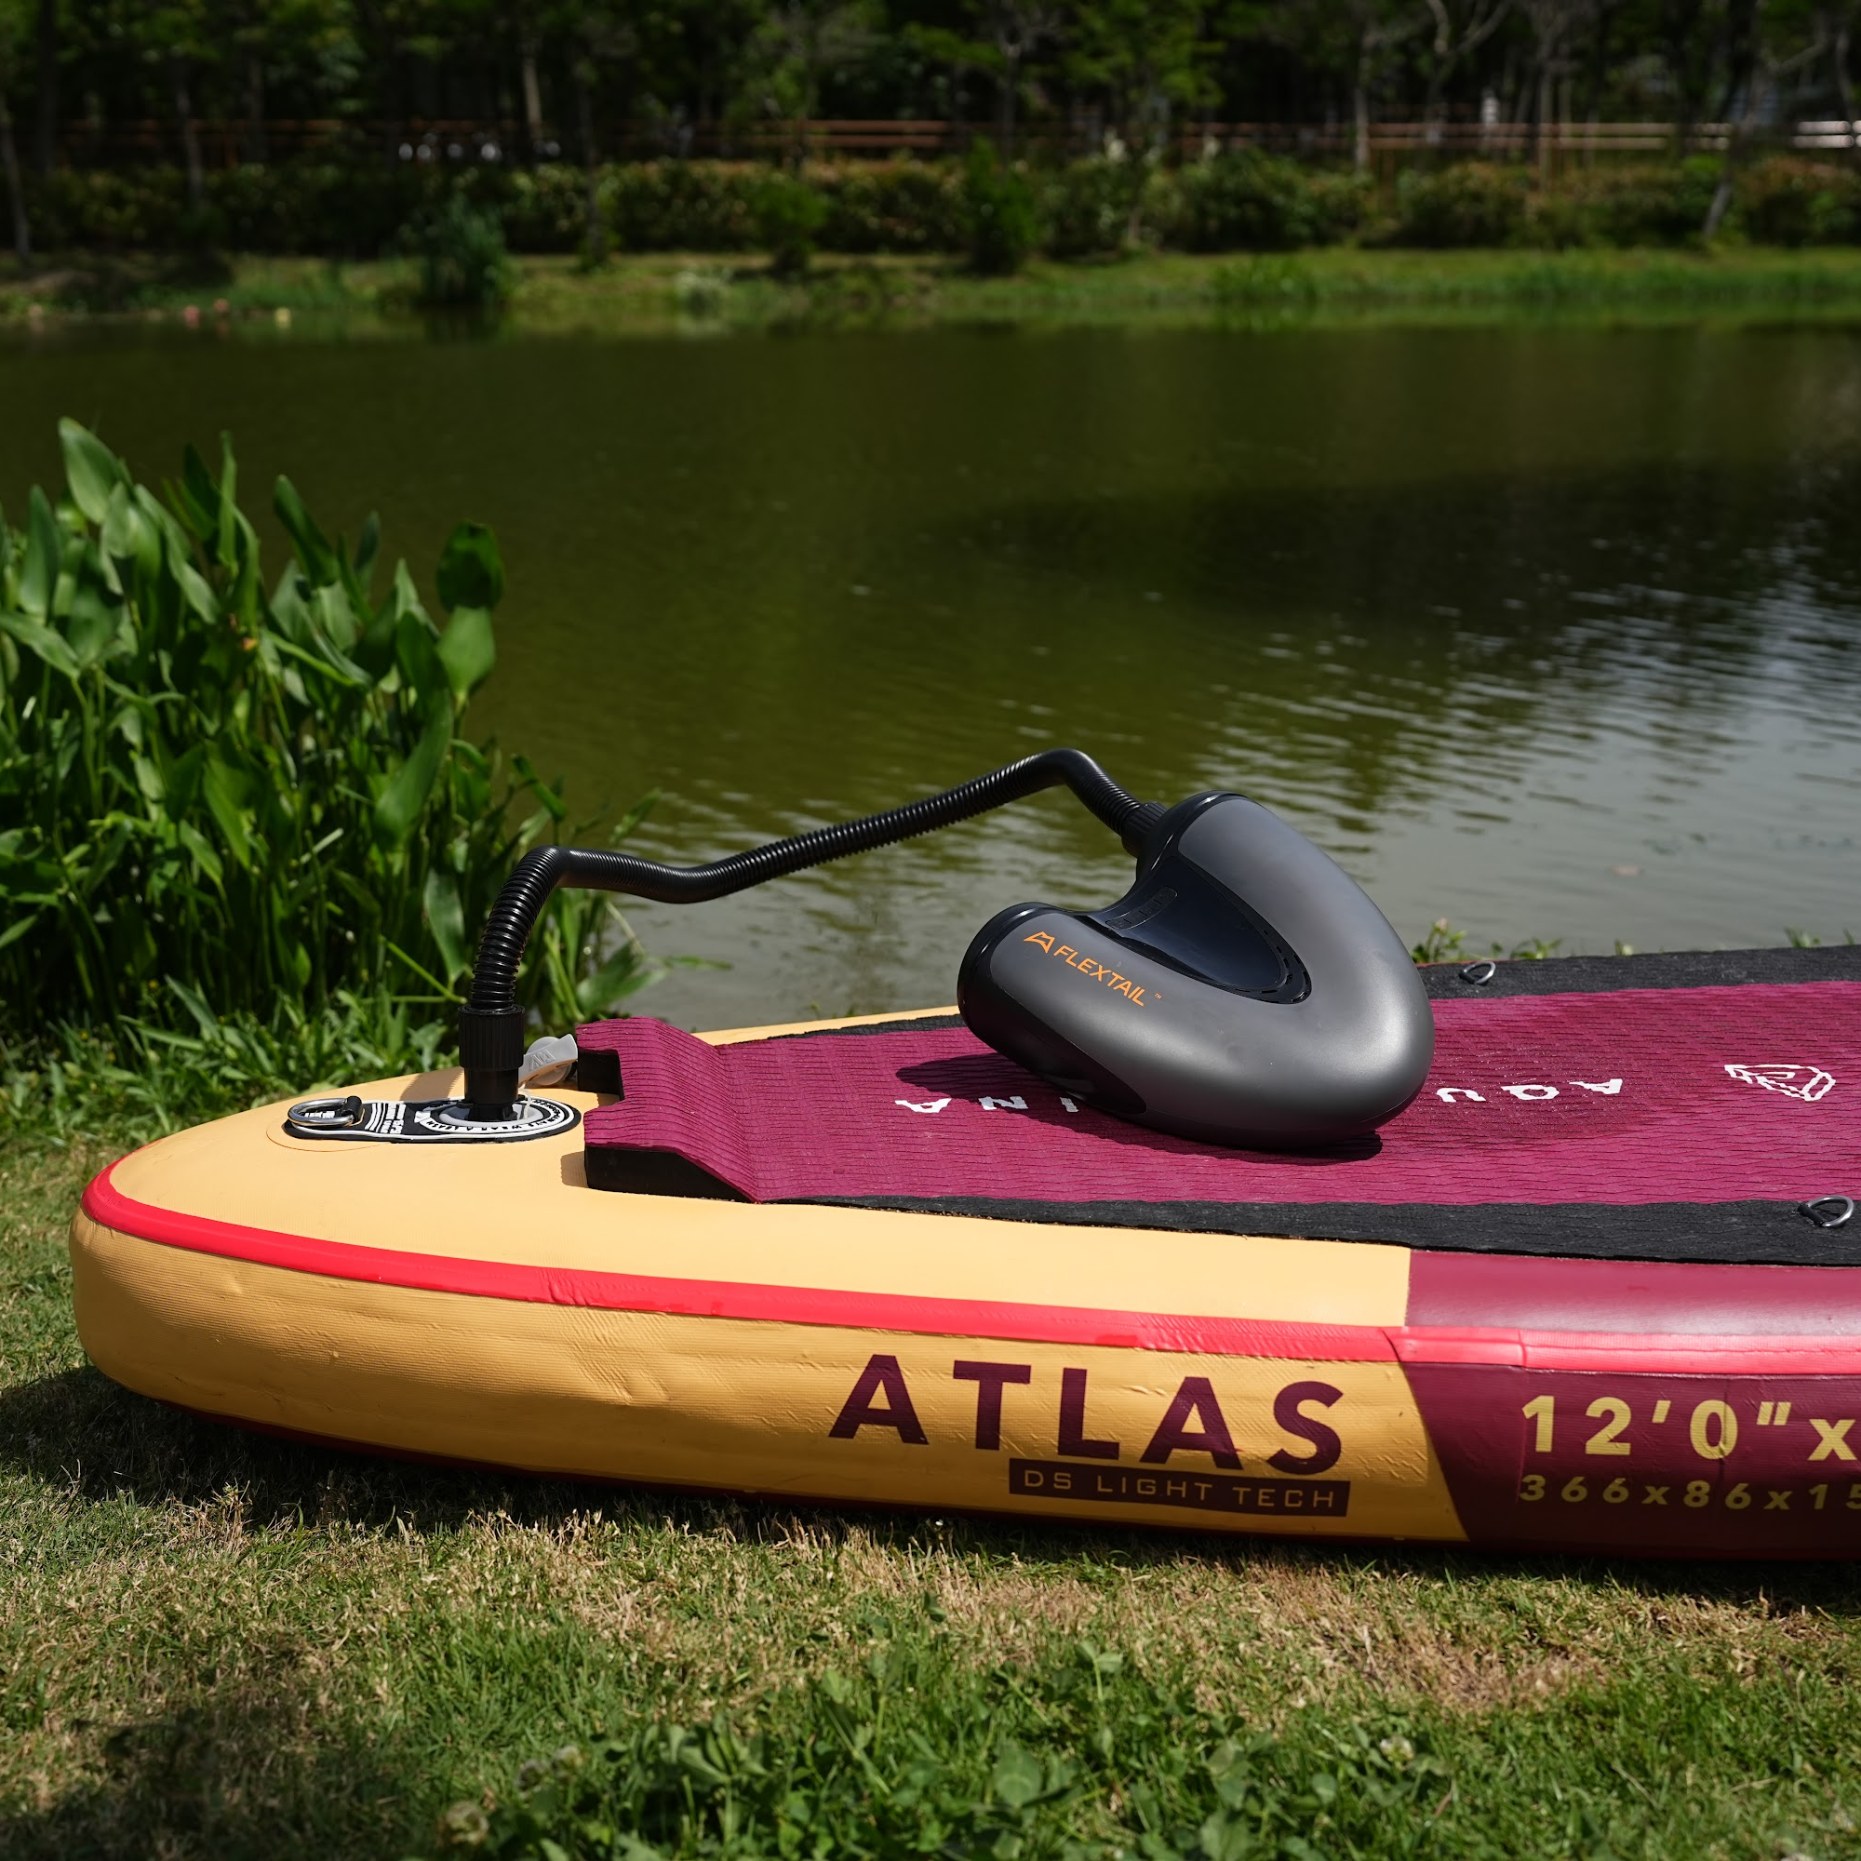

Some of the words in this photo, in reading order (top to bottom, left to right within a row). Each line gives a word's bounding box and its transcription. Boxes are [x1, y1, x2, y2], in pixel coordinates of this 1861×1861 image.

[1053, 944, 1146, 1008] FLEXTAIL
[1436, 1078, 1623, 1103] AQU
[828, 1354, 1344, 1475] ATLAS
[1024, 1470, 1072, 1490] DS
[1097, 1475, 1213, 1501] LIGHT
[1232, 1486, 1335, 1508] TECH
